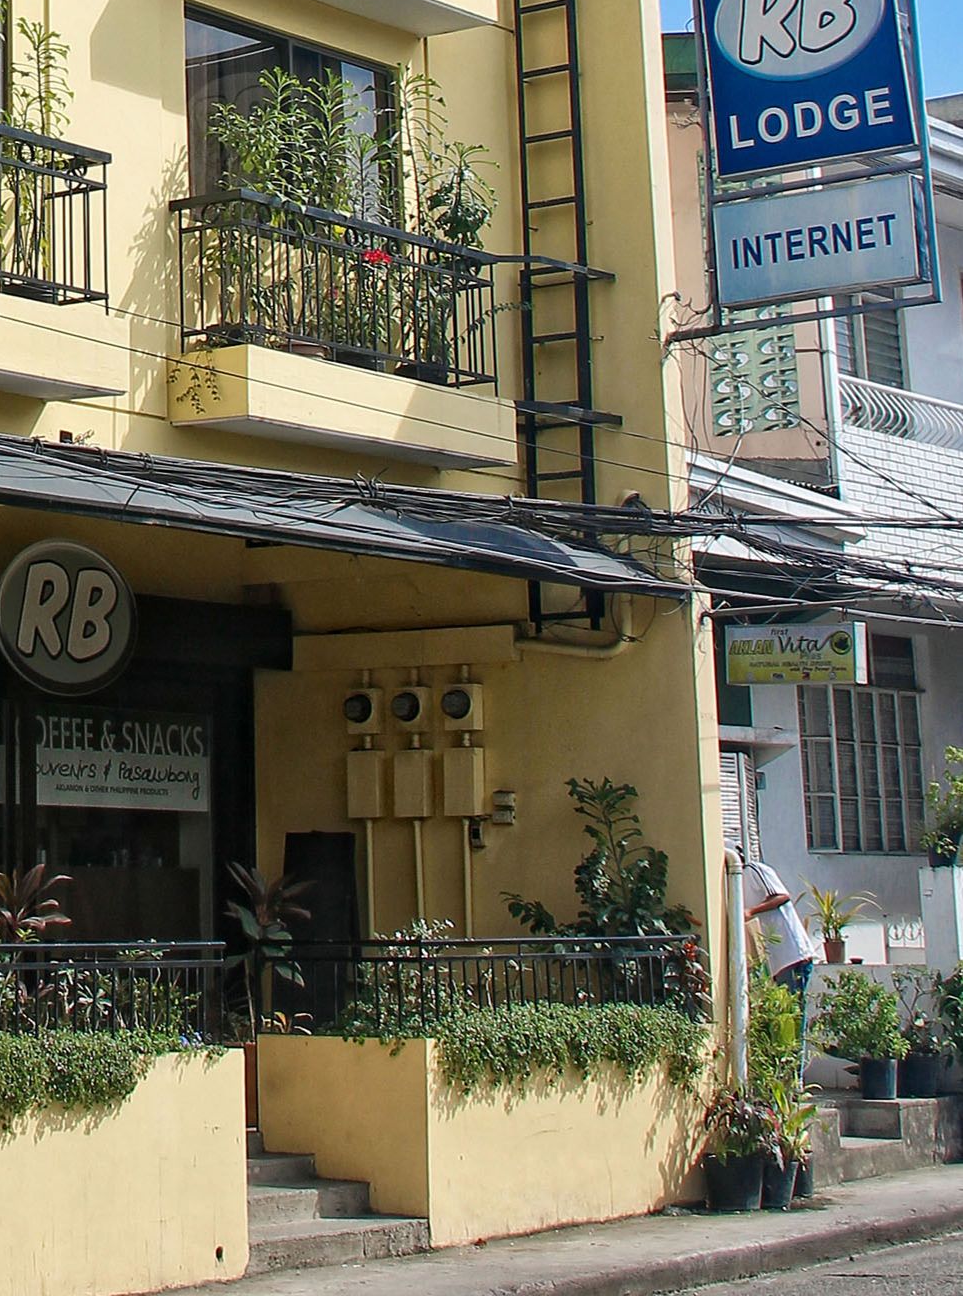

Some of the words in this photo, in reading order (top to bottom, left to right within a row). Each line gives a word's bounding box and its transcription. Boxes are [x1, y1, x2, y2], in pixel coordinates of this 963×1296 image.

[730, 87, 894, 150] LODGE
[731, 213, 897, 270] INTERNET
[16, 559, 118, 663] RB
[778, 635, 822, 653] Vita
[101, 720, 116, 752] &
[122, 722, 204, 757] SNACKS
[36, 760, 97, 780] ouvenirs
[119, 761, 200, 800] Pasalubong
